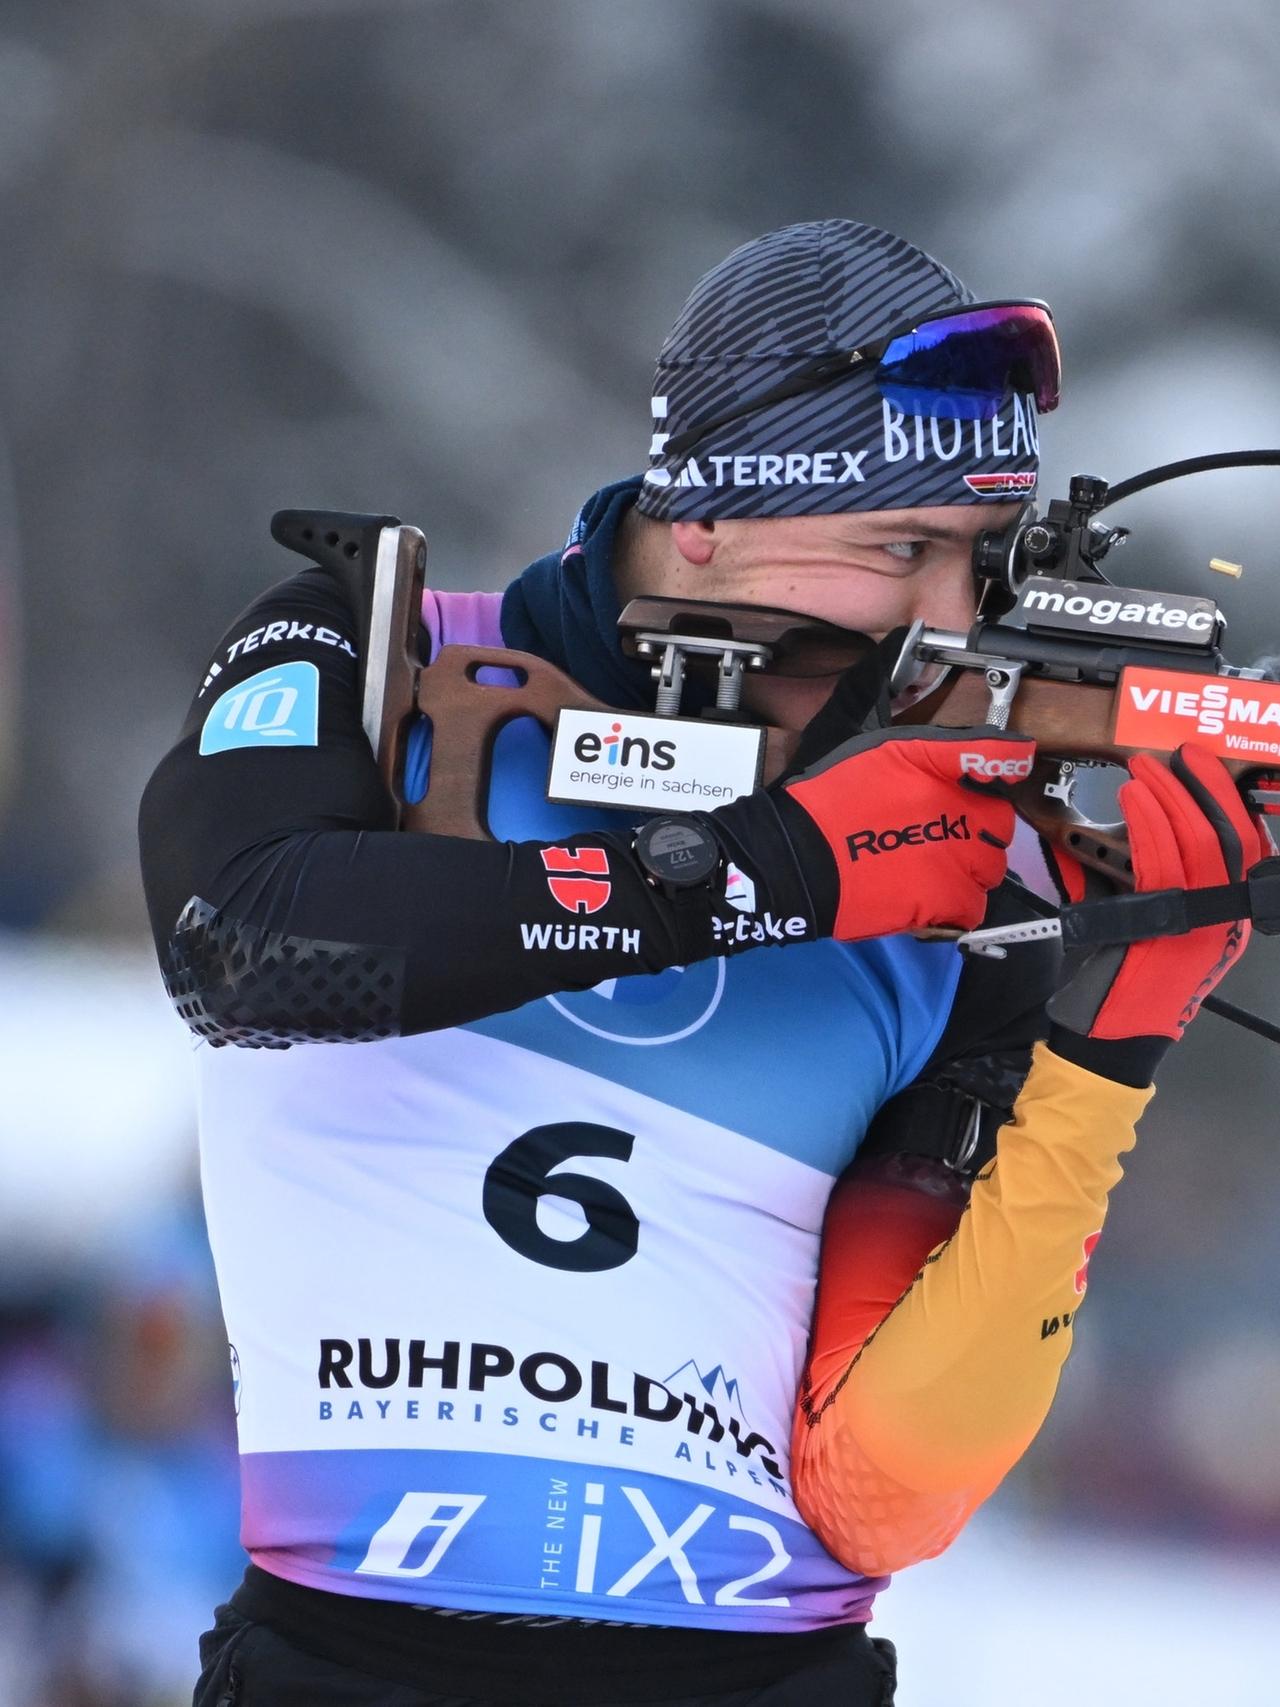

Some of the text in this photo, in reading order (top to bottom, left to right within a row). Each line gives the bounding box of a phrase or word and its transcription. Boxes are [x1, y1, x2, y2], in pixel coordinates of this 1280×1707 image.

[708, 451, 868, 486] TERREX
[1022, 590, 1215, 631] mogatec
[574, 722, 677, 771] eins
[569, 770, 734, 799] energie in sachsen
[520, 923, 640, 954] WÜRTH
[482, 1121, 640, 1273] 6
[319, 1401, 634, 1447] BAYERISCHE
[540, 1477, 569, 1588] THE NEW
[574, 1482, 791, 1608] iX2
